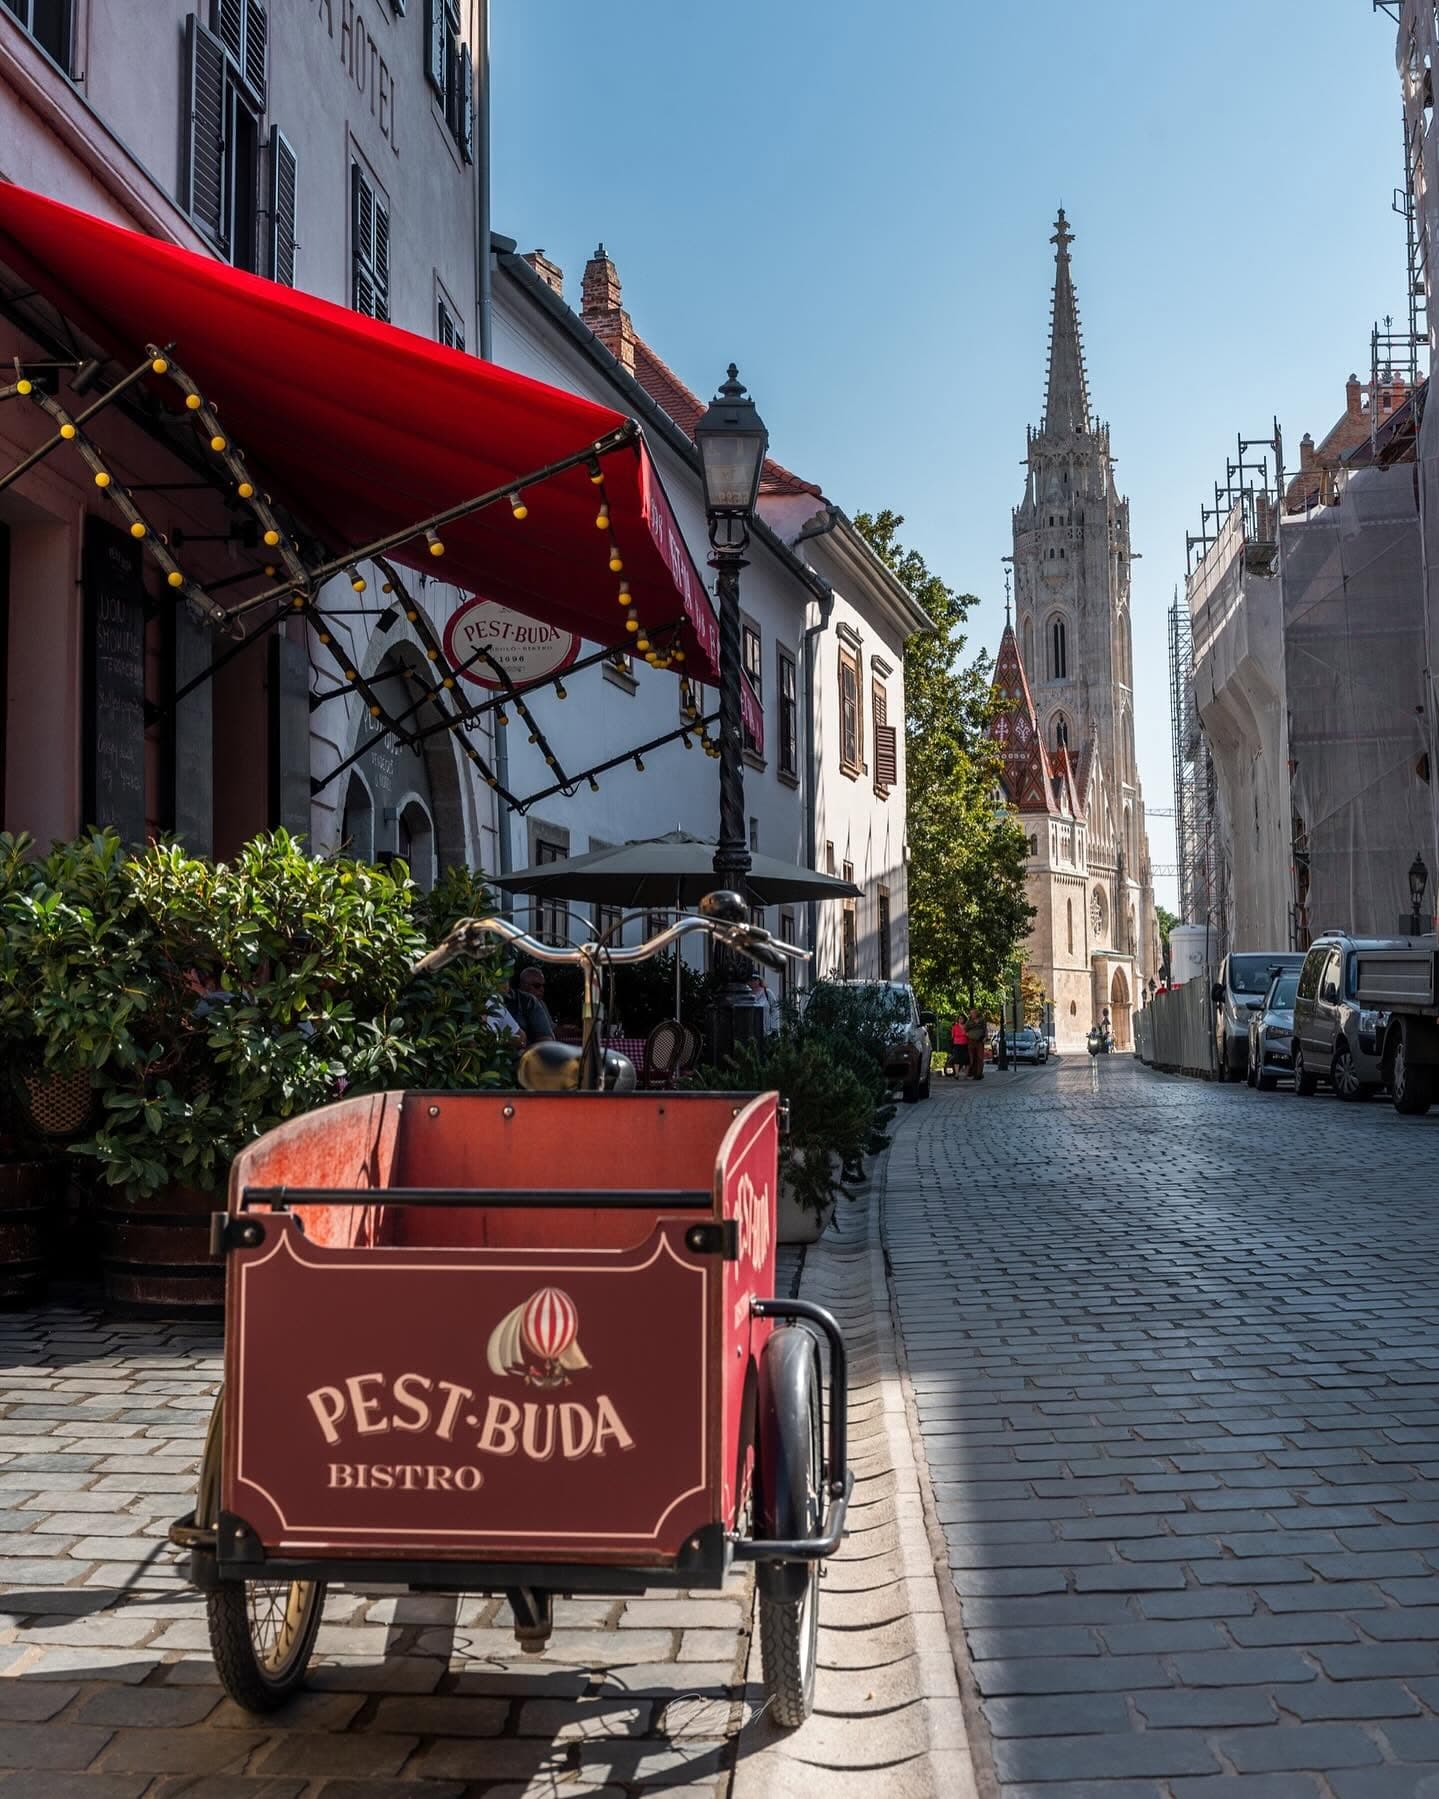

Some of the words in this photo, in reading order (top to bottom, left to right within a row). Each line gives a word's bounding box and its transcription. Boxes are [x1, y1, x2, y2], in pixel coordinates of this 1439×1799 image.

[341, 0, 399, 160] HOTEL
[306, 1373, 636, 1461] PEST·BUDA
[328, 1463, 484, 1490] BISTRO
